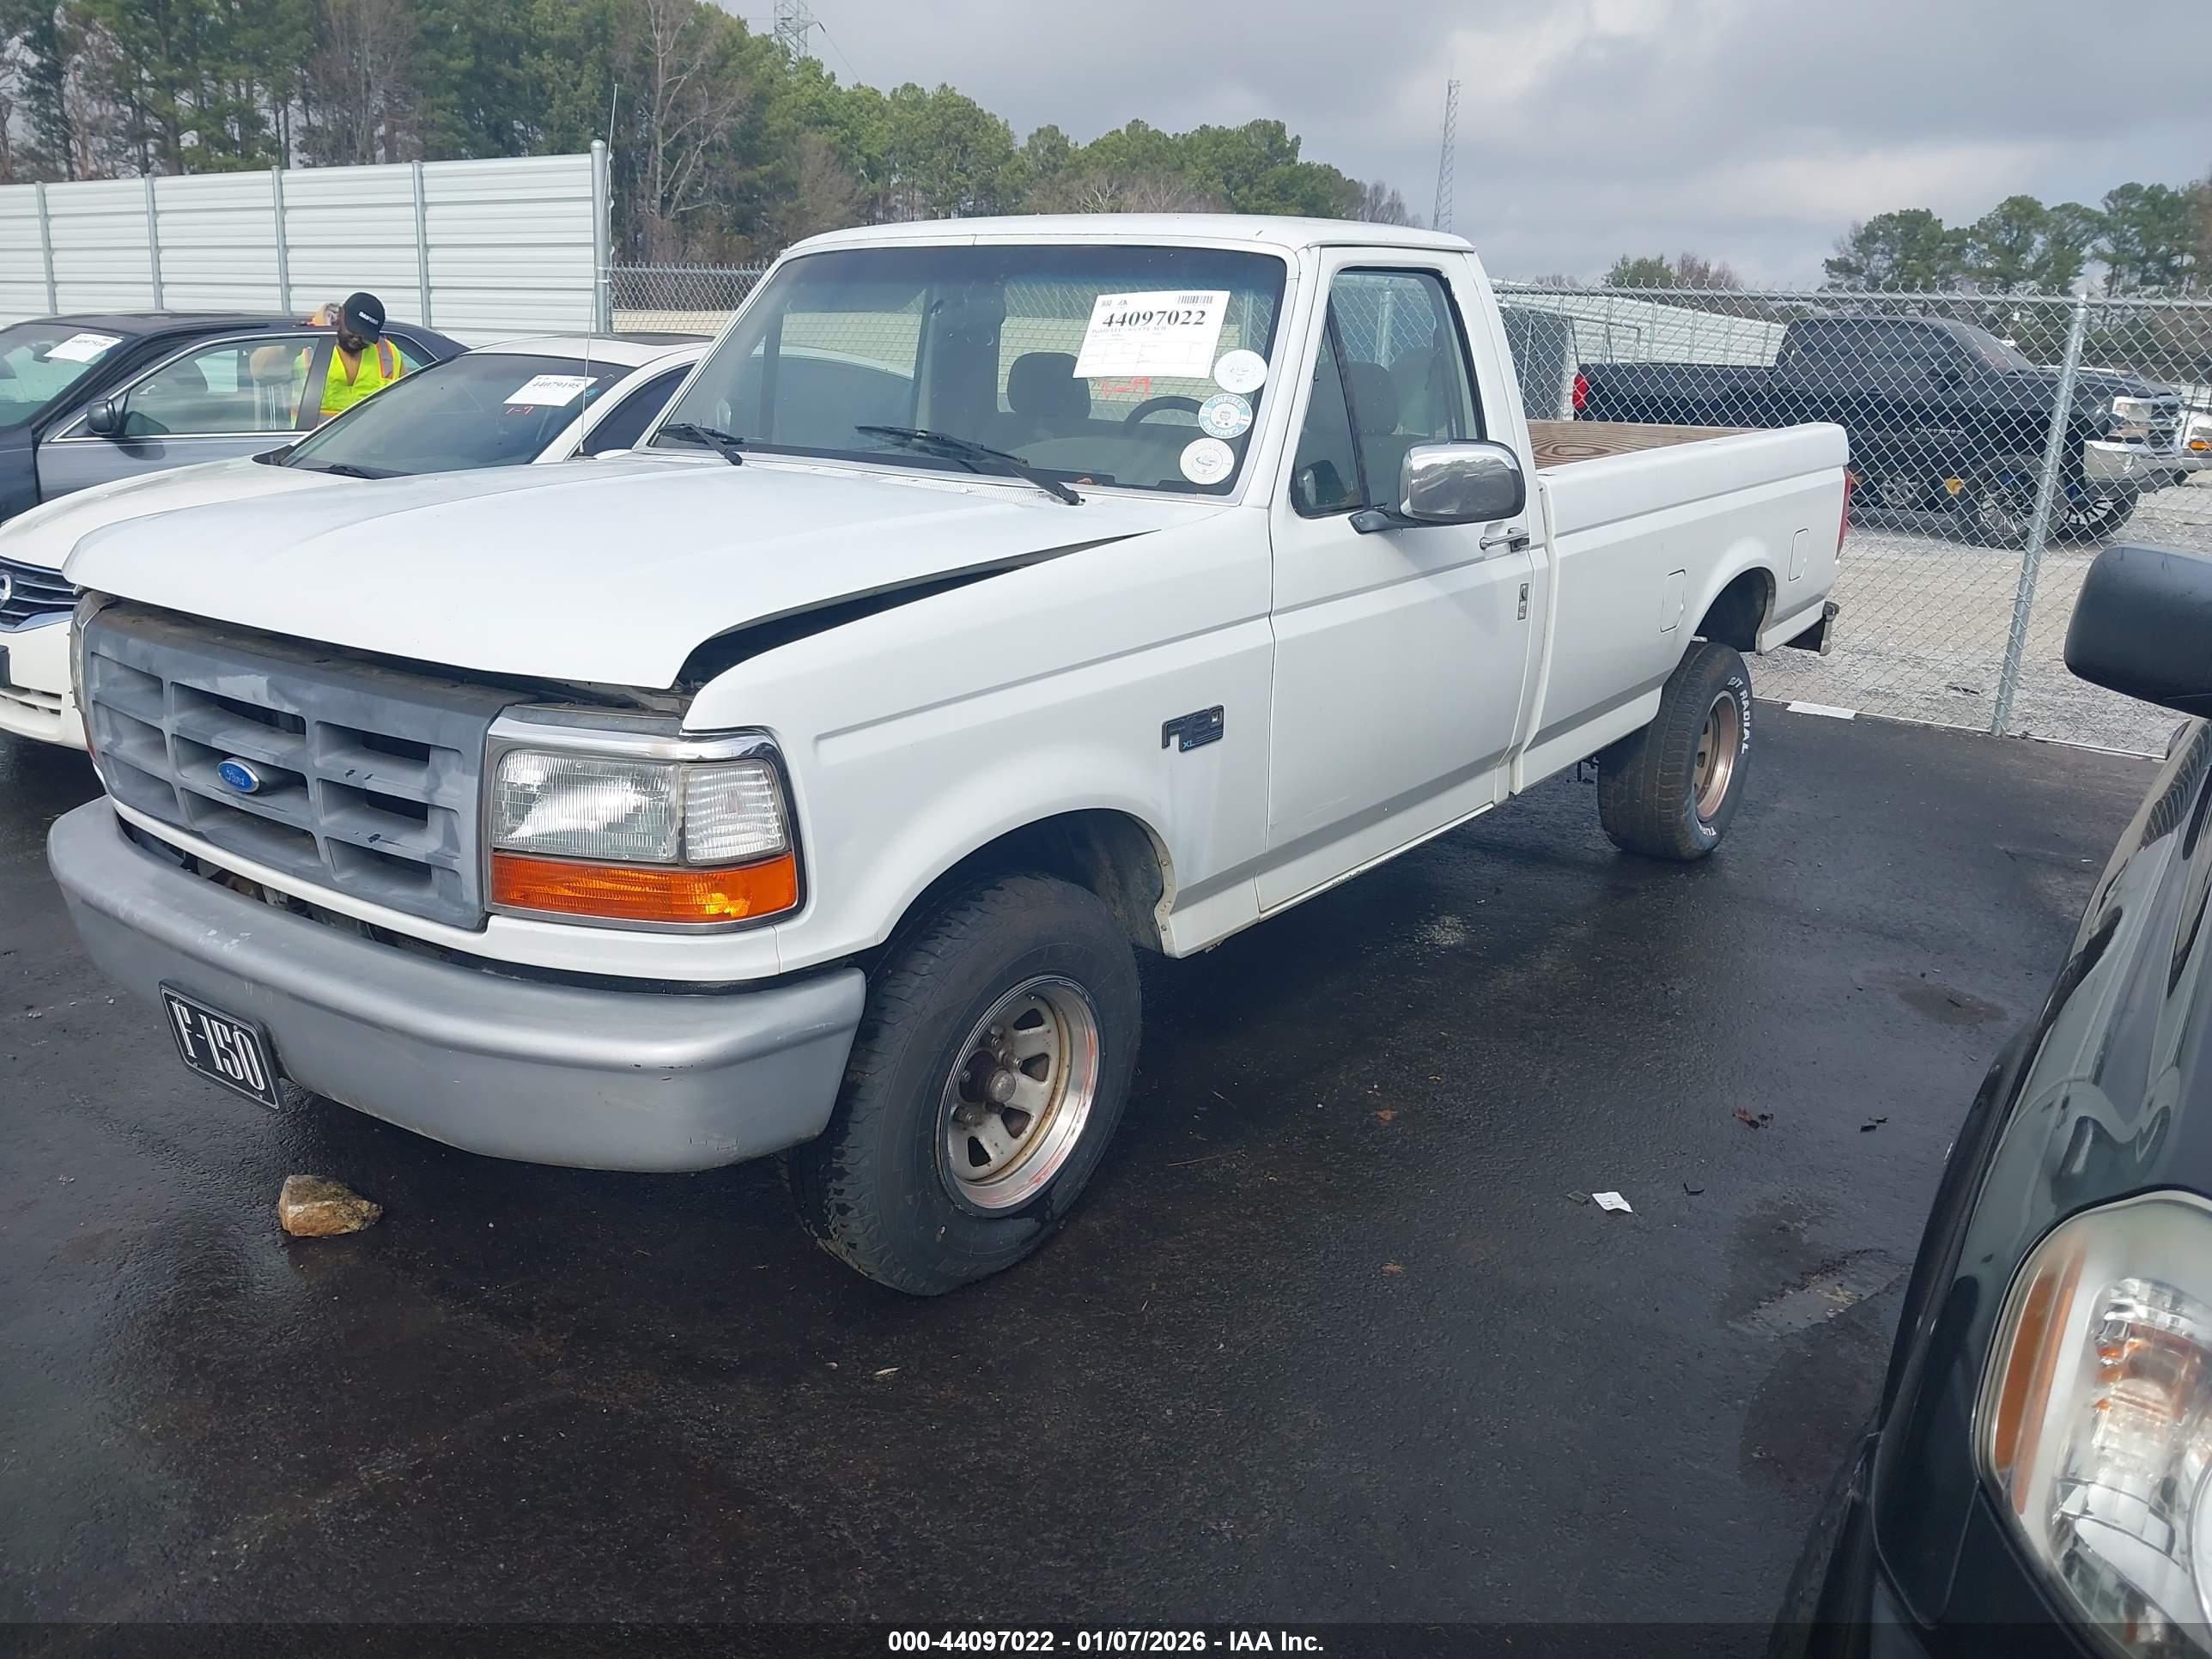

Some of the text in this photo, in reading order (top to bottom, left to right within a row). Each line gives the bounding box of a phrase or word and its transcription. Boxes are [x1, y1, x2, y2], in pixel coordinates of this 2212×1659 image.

[1102, 310, 1206, 327] 44097022
[1739, 690, 1751, 754] RADIAL
[225, 766, 246, 787] Ford
[170, 1000, 264, 1091] F-150
